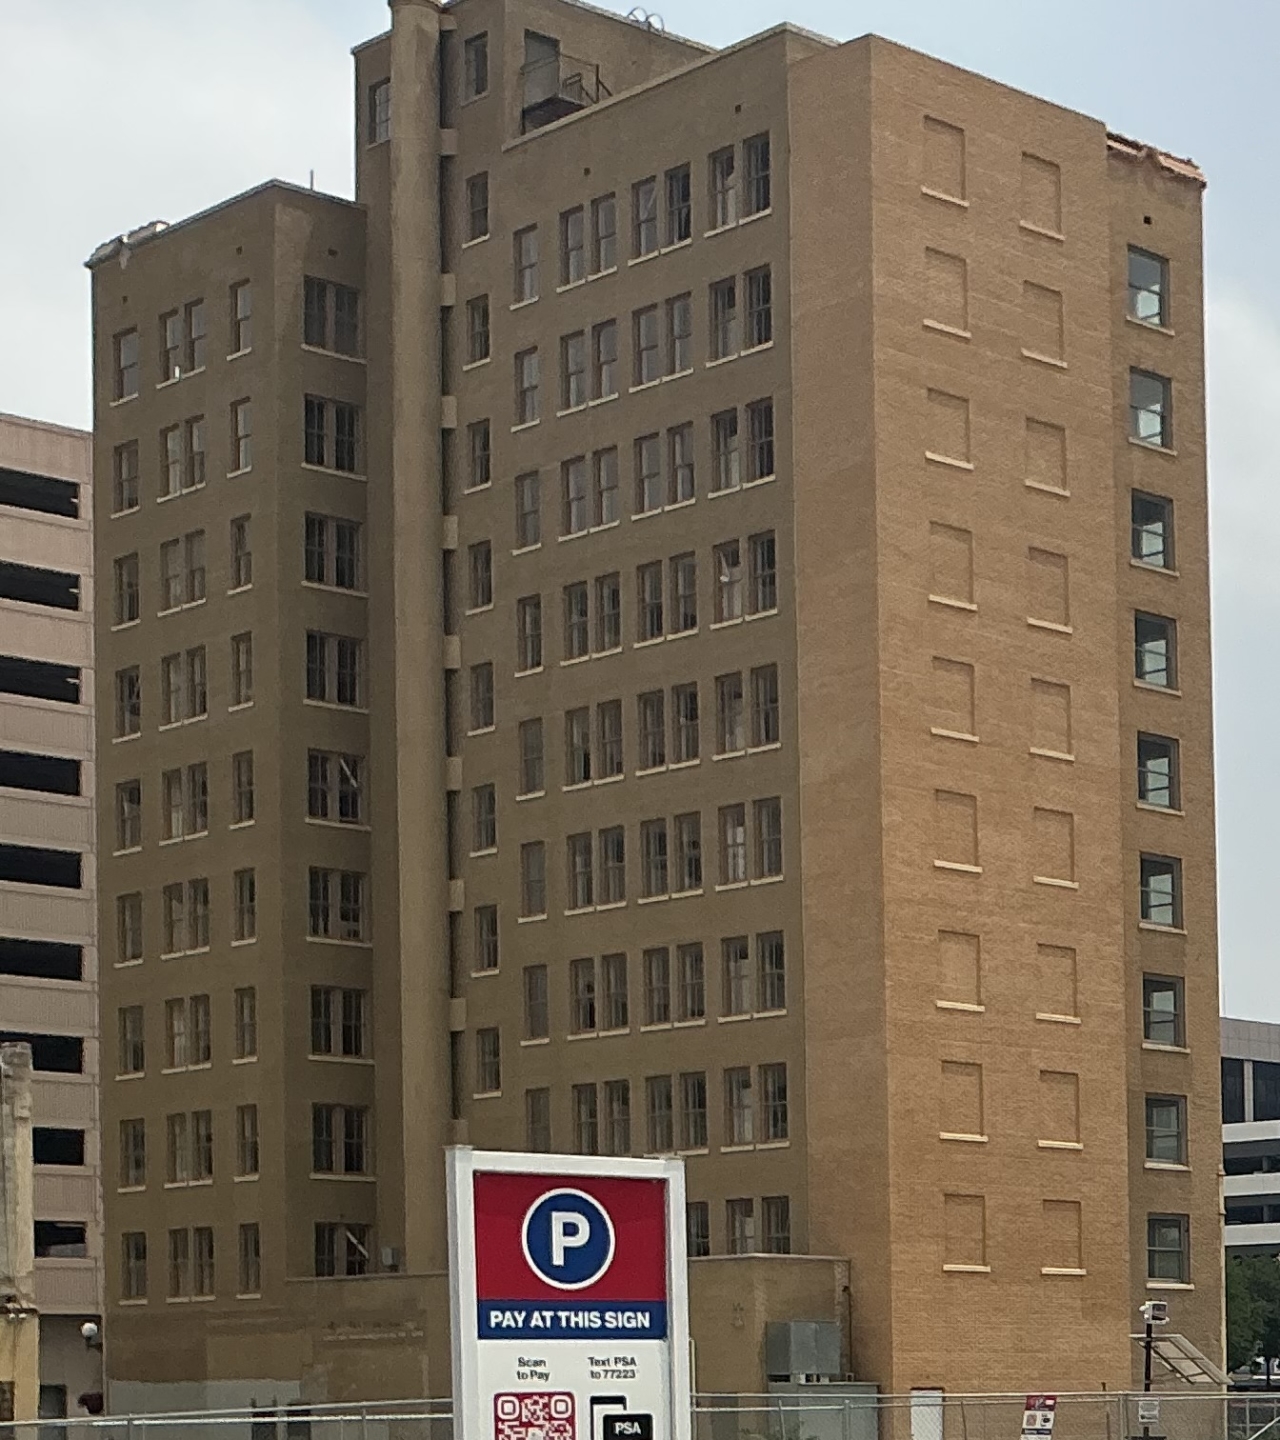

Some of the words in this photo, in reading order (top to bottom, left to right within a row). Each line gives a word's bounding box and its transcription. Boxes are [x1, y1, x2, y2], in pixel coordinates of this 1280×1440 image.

[551, 1211, 591, 1267] P
[490, 1310, 526, 1328] PAY
[530, 1310, 554, 1328] AT
[557, 1310, 602, 1328] THIS
[604, 1310, 650, 1329] SIGN
[517, 1356, 547, 1367] Scan
[588, 1356, 611, 1367] Text
[614, 1356, 638, 1367] PSA
[516, 1370, 528, 1380] to
[530, 1370, 550, 1383] Pay
[590, 1370, 601, 1379] to
[602, 1369, 636, 1379] 77223
[614, 1421, 642, 1436] PSA
